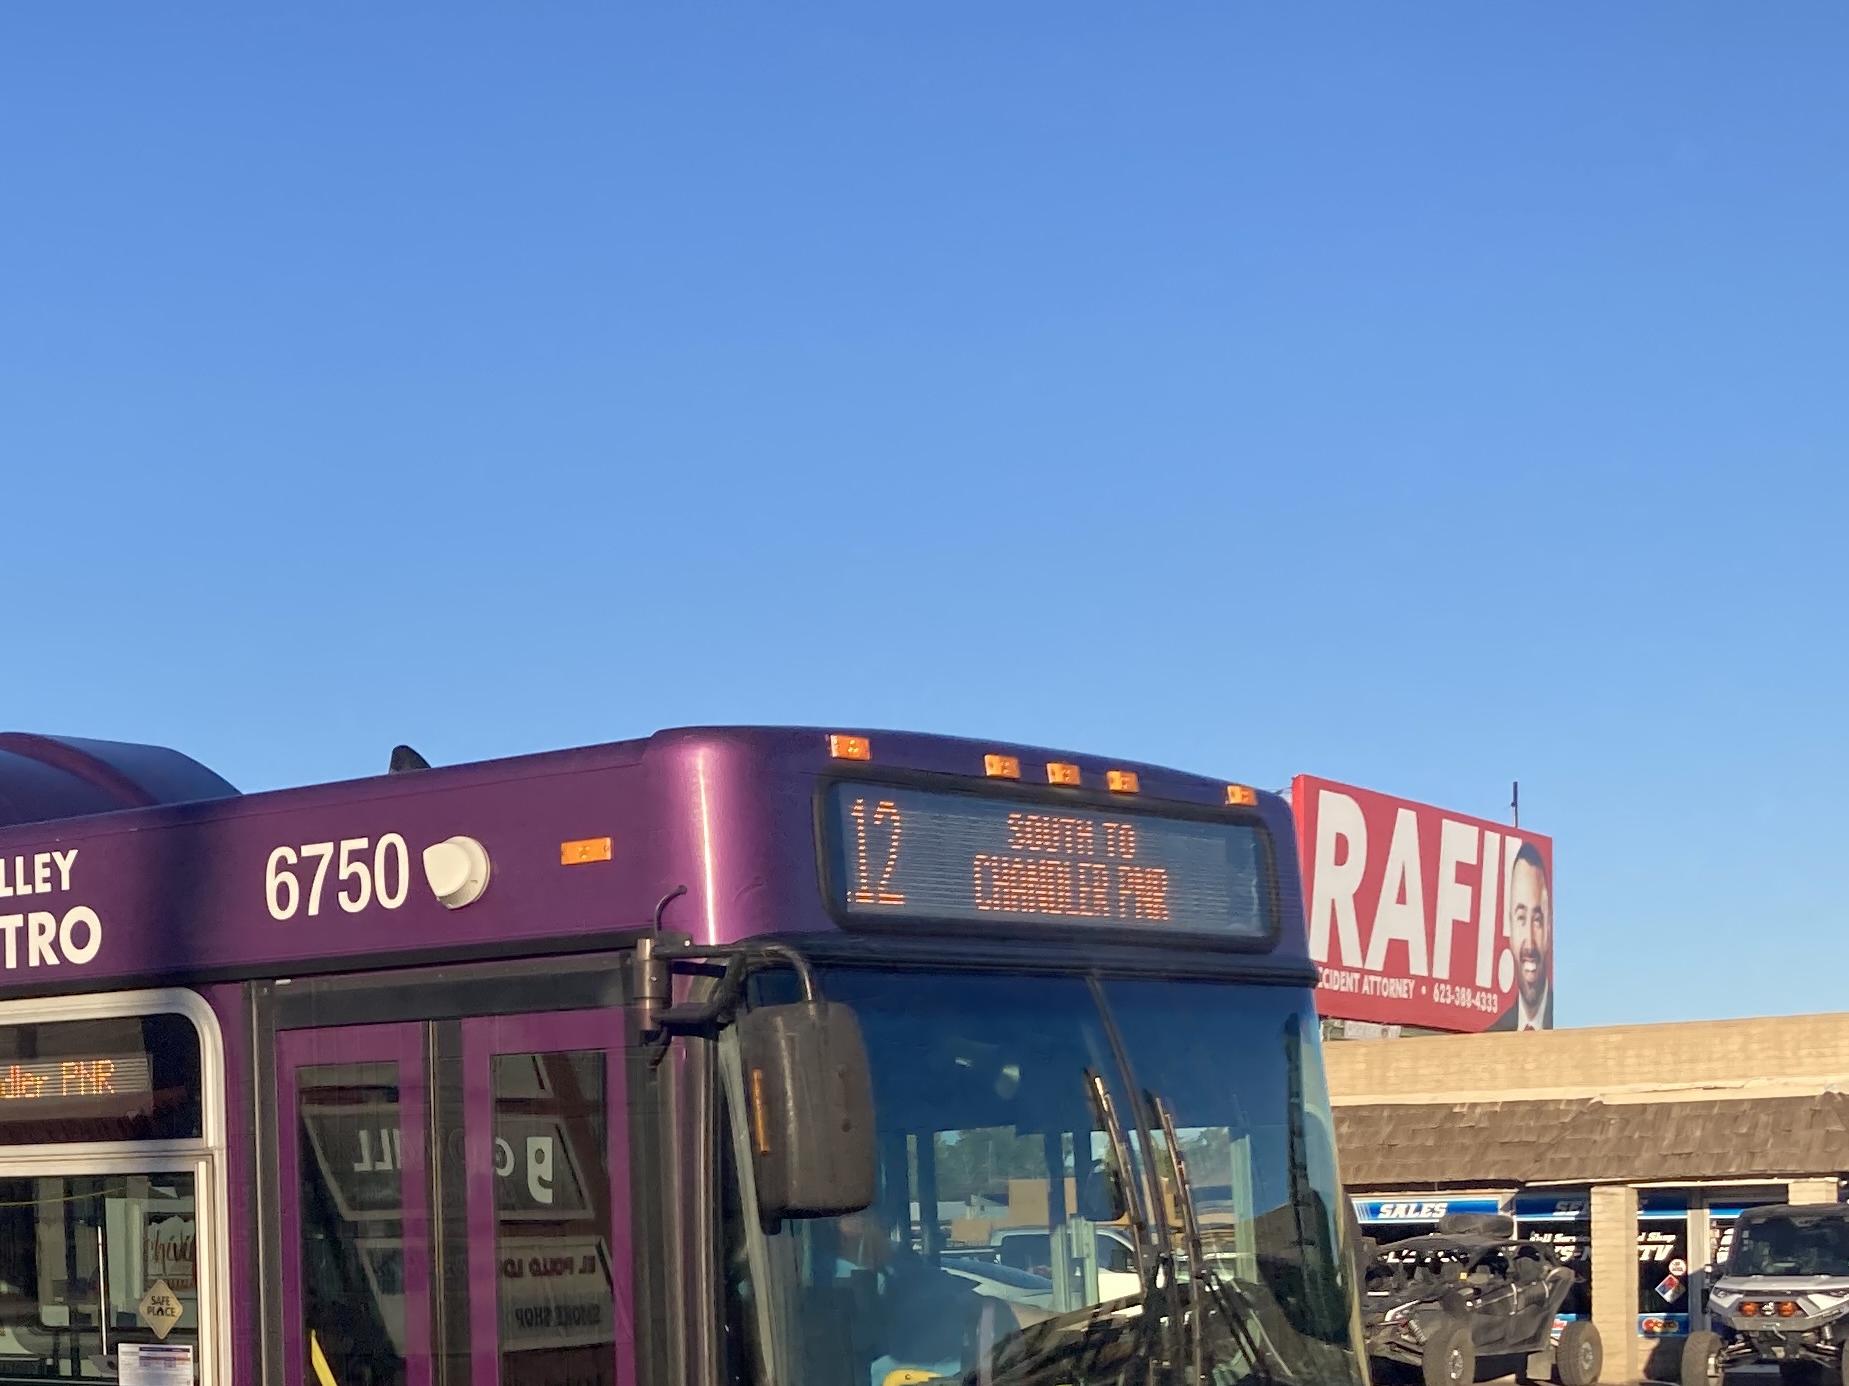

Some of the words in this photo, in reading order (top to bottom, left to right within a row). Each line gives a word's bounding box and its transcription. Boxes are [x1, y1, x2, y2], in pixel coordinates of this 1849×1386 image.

[1007, 813, 1094, 856] SOUTH
[1101, 822, 1137, 859] TO
[265, 832, 410, 921] 6750
[973, 854, 1112, 918] CHANDLER
[1308, 789, 1523, 994] RAFI!
[1361, 974, 1416, 999] ATTORNEY
[61, 1059, 116, 1096] PNR
[1378, 1202, 1448, 1219] SALES
[151, 1295, 171, 1306] SAFE
